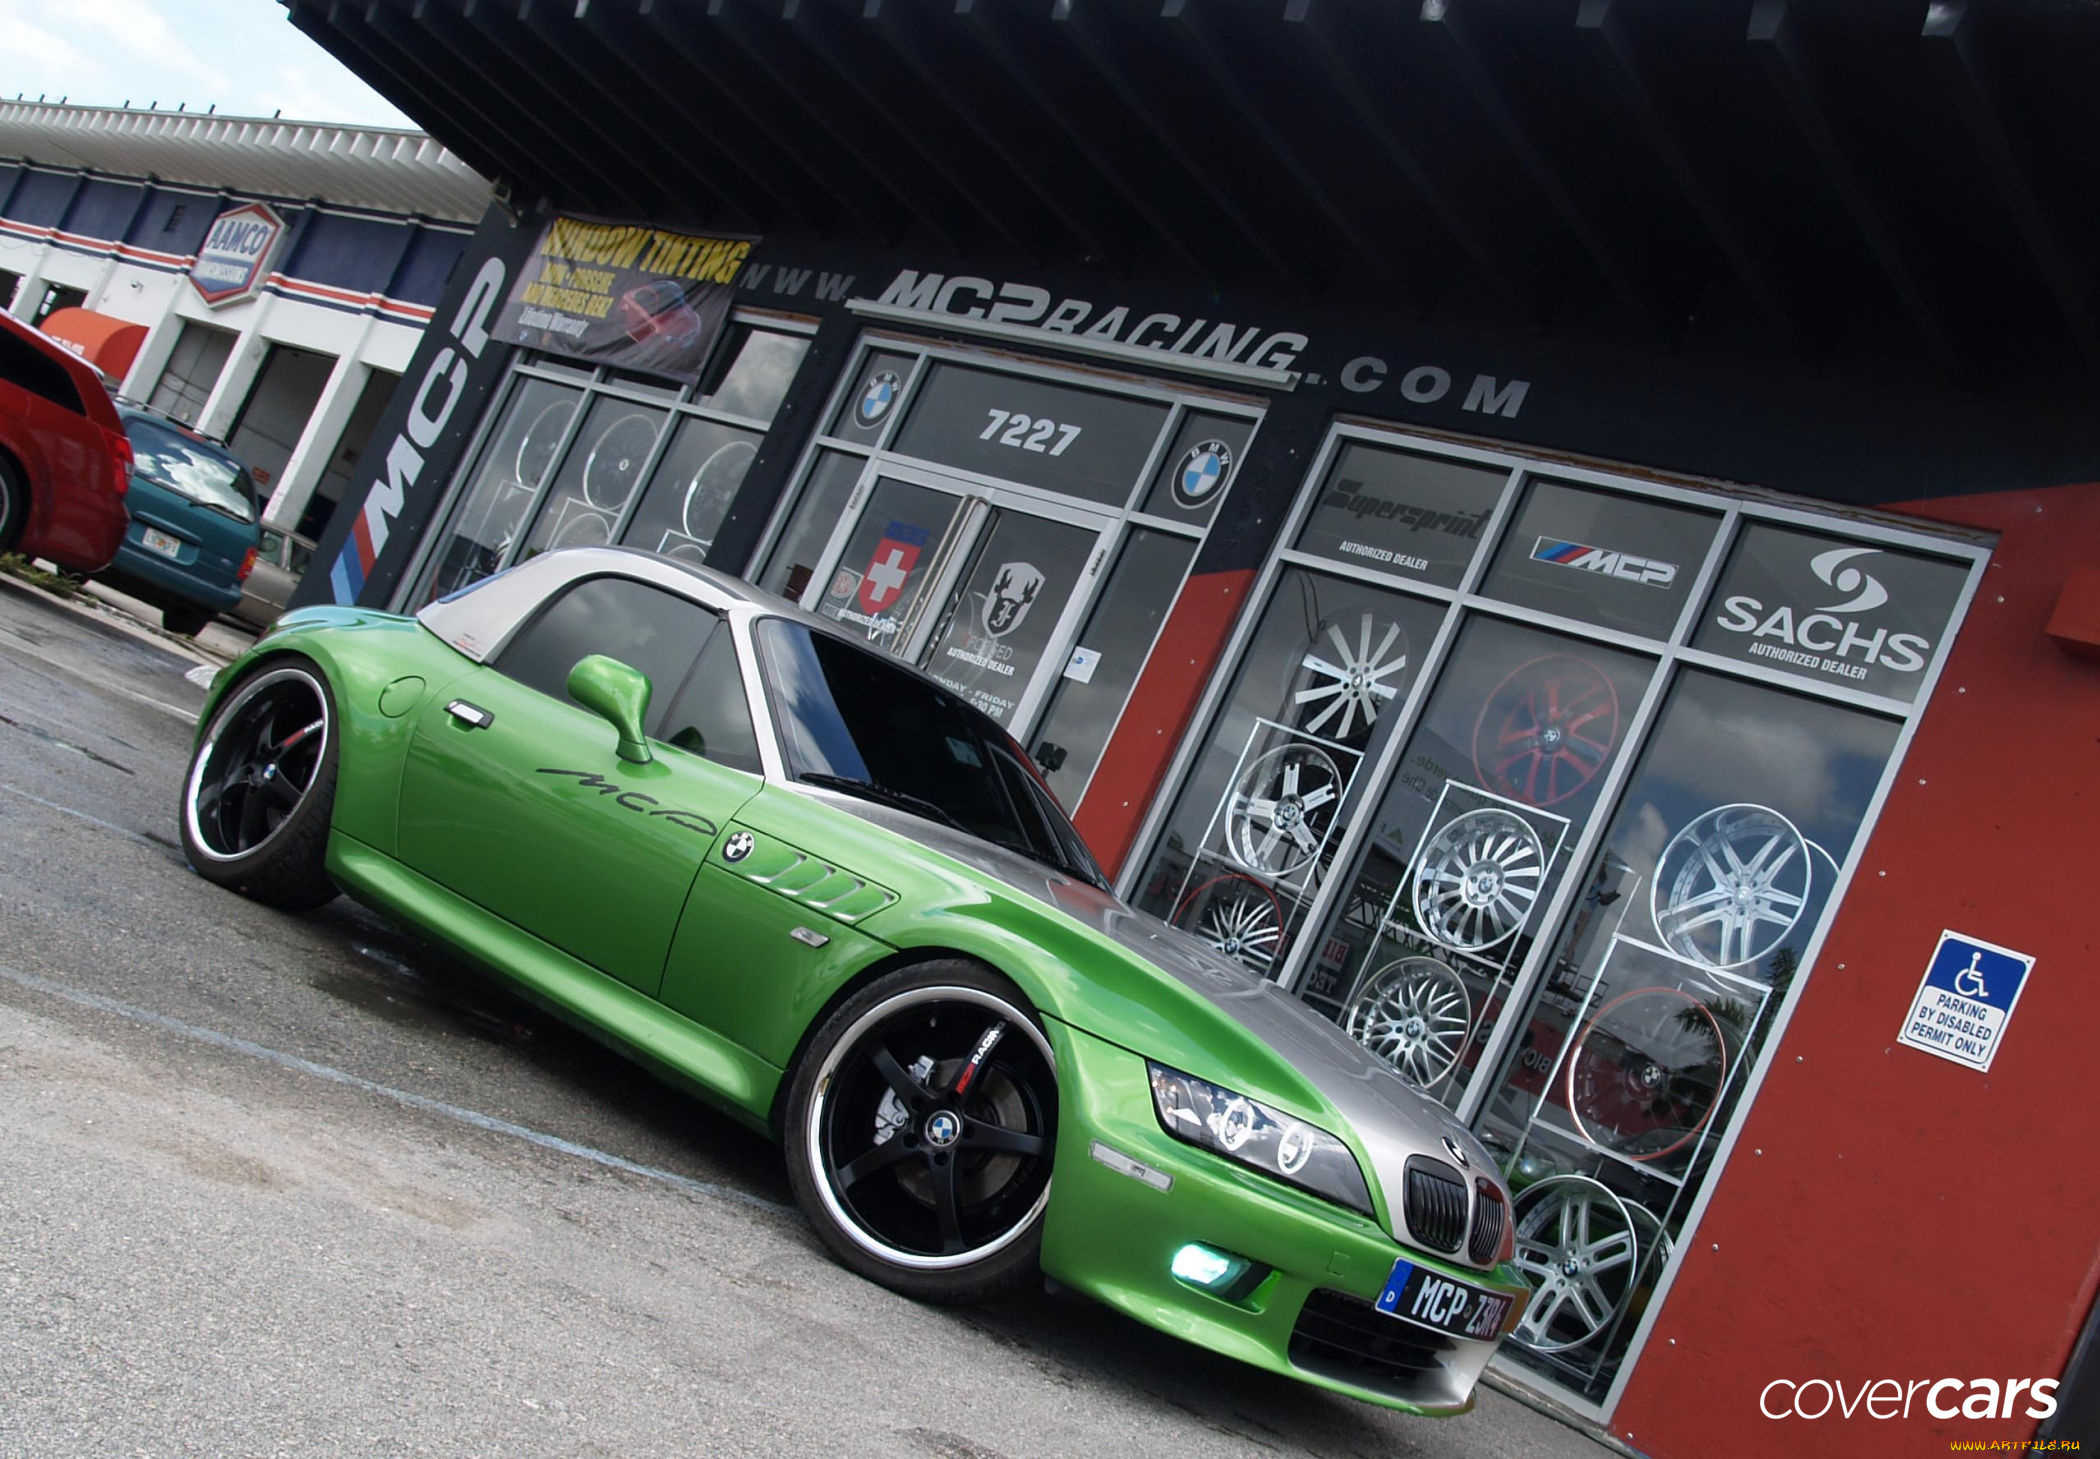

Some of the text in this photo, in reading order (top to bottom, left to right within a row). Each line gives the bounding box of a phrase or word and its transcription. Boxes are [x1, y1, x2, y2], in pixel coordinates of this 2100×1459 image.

[206, 219, 268, 255] AAMCO
[540, 217, 753, 284] WINDOW TINTING
[364, 257, 506, 559] MCP
[979, 408, 1082, 457] 7227
[1322, 478, 1494, 540] Supersprint
[1339, 540, 1429, 571] AUTHORIZED DEALER
[1568, 550, 1677, 583] MCP
[1717, 596, 1930, 672] SACHS
[947, 647, 1015, 676] AUTHORIZED DEALER
[1748, 642, 1868, 680] AUTHORIZED DEALER
[974, 690, 1015, 709] FRIDAY
[536, 768, 718, 837] MCP
[1919, 1006, 1992, 1040] BY DISABLED
[1936, 993, 1987, 1021] PARKING
[1911, 1022, 1986, 1057] PERMIT ONLY
[1385, 1290, 1396, 1303] D
